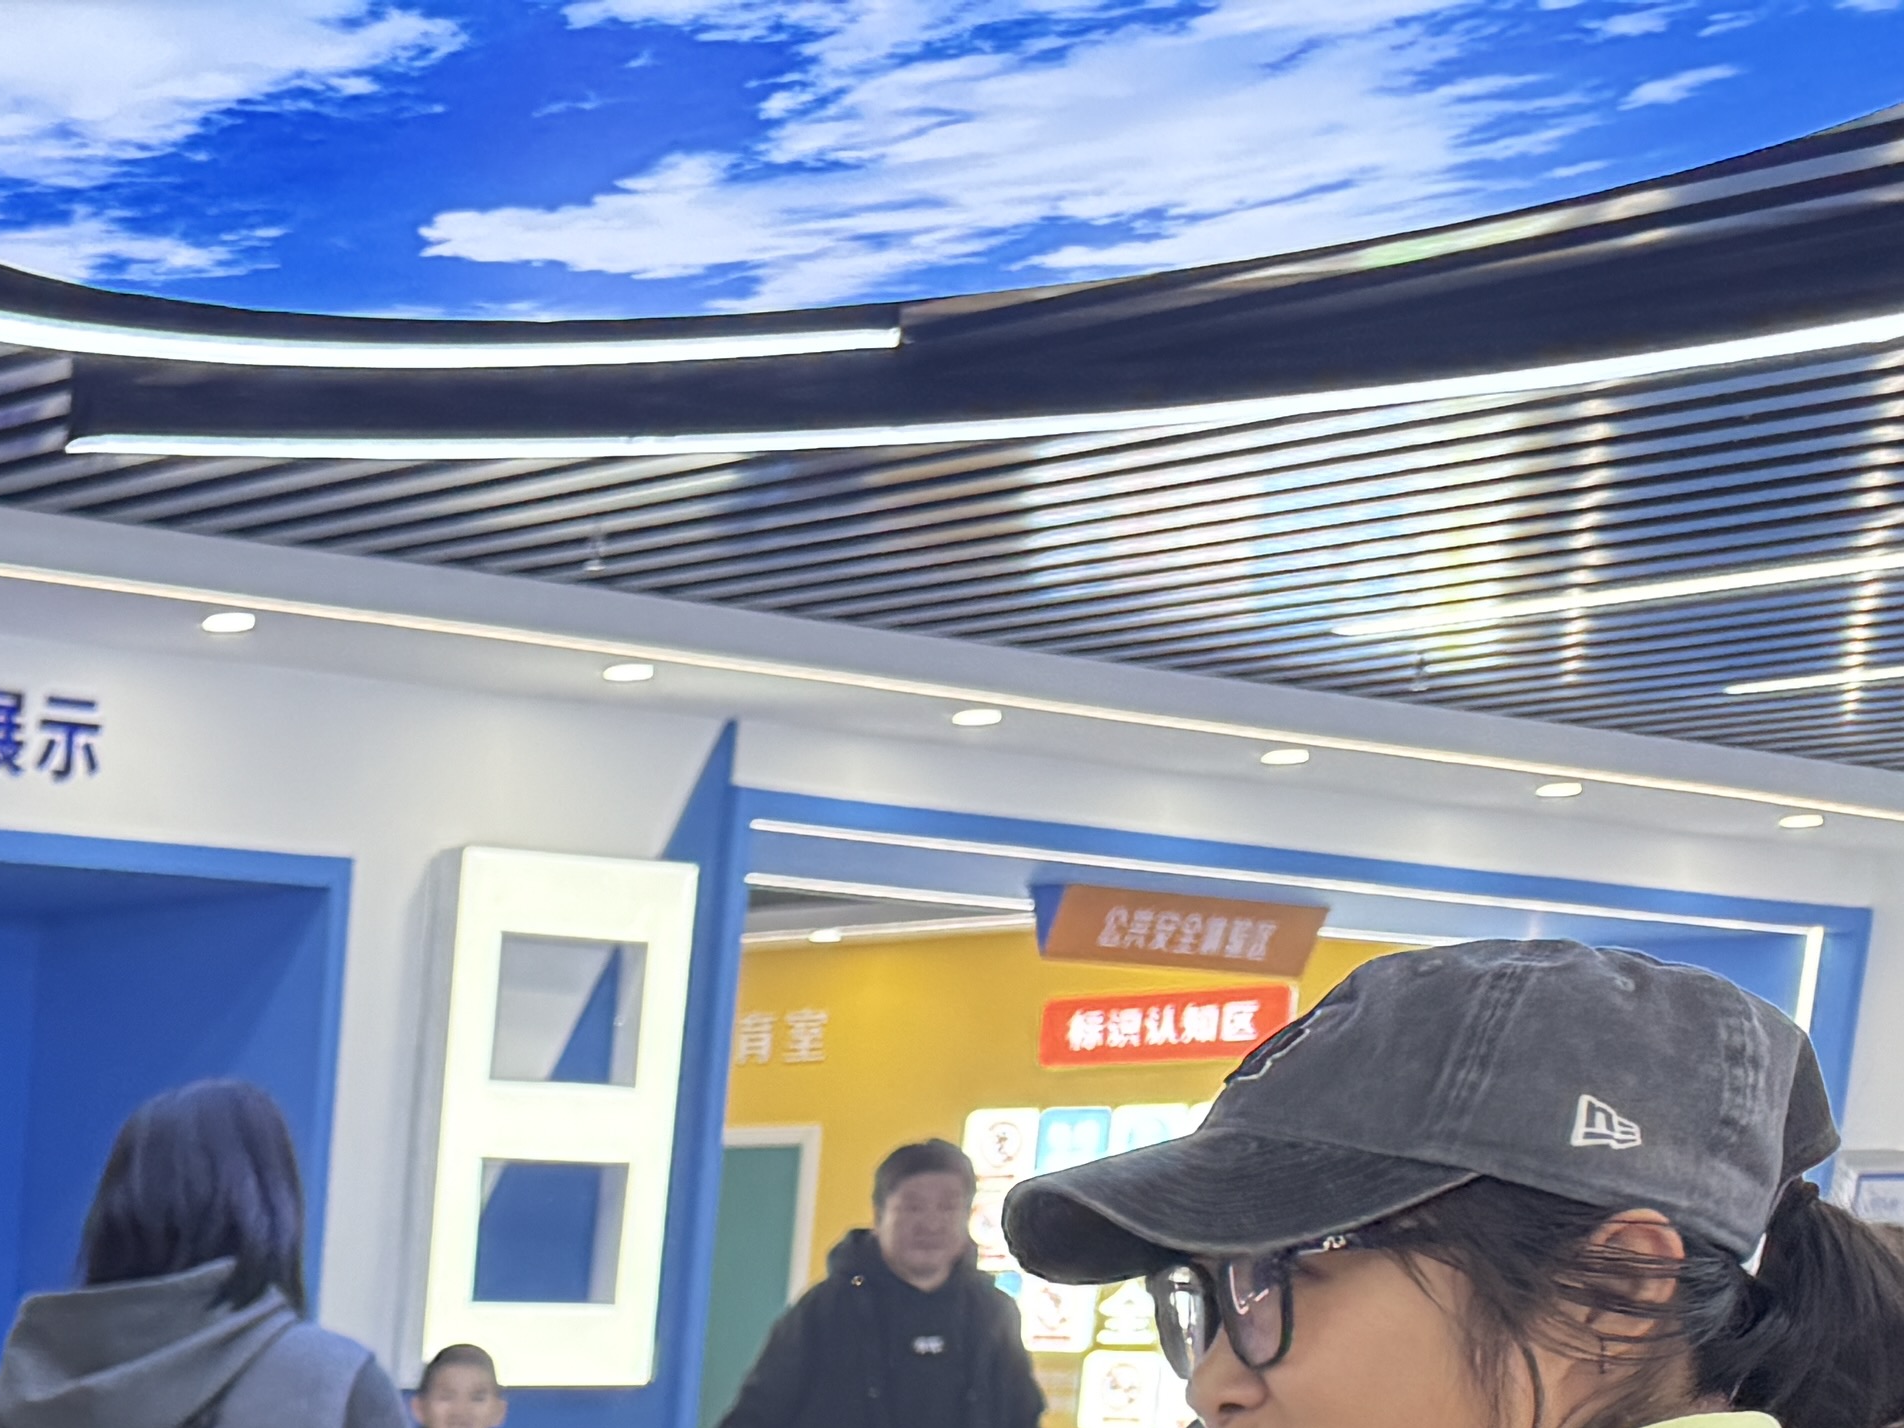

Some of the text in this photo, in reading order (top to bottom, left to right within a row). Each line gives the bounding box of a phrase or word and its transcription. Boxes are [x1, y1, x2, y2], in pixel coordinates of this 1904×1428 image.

[1066, 1000, 1261, 1051] 标识认知区
